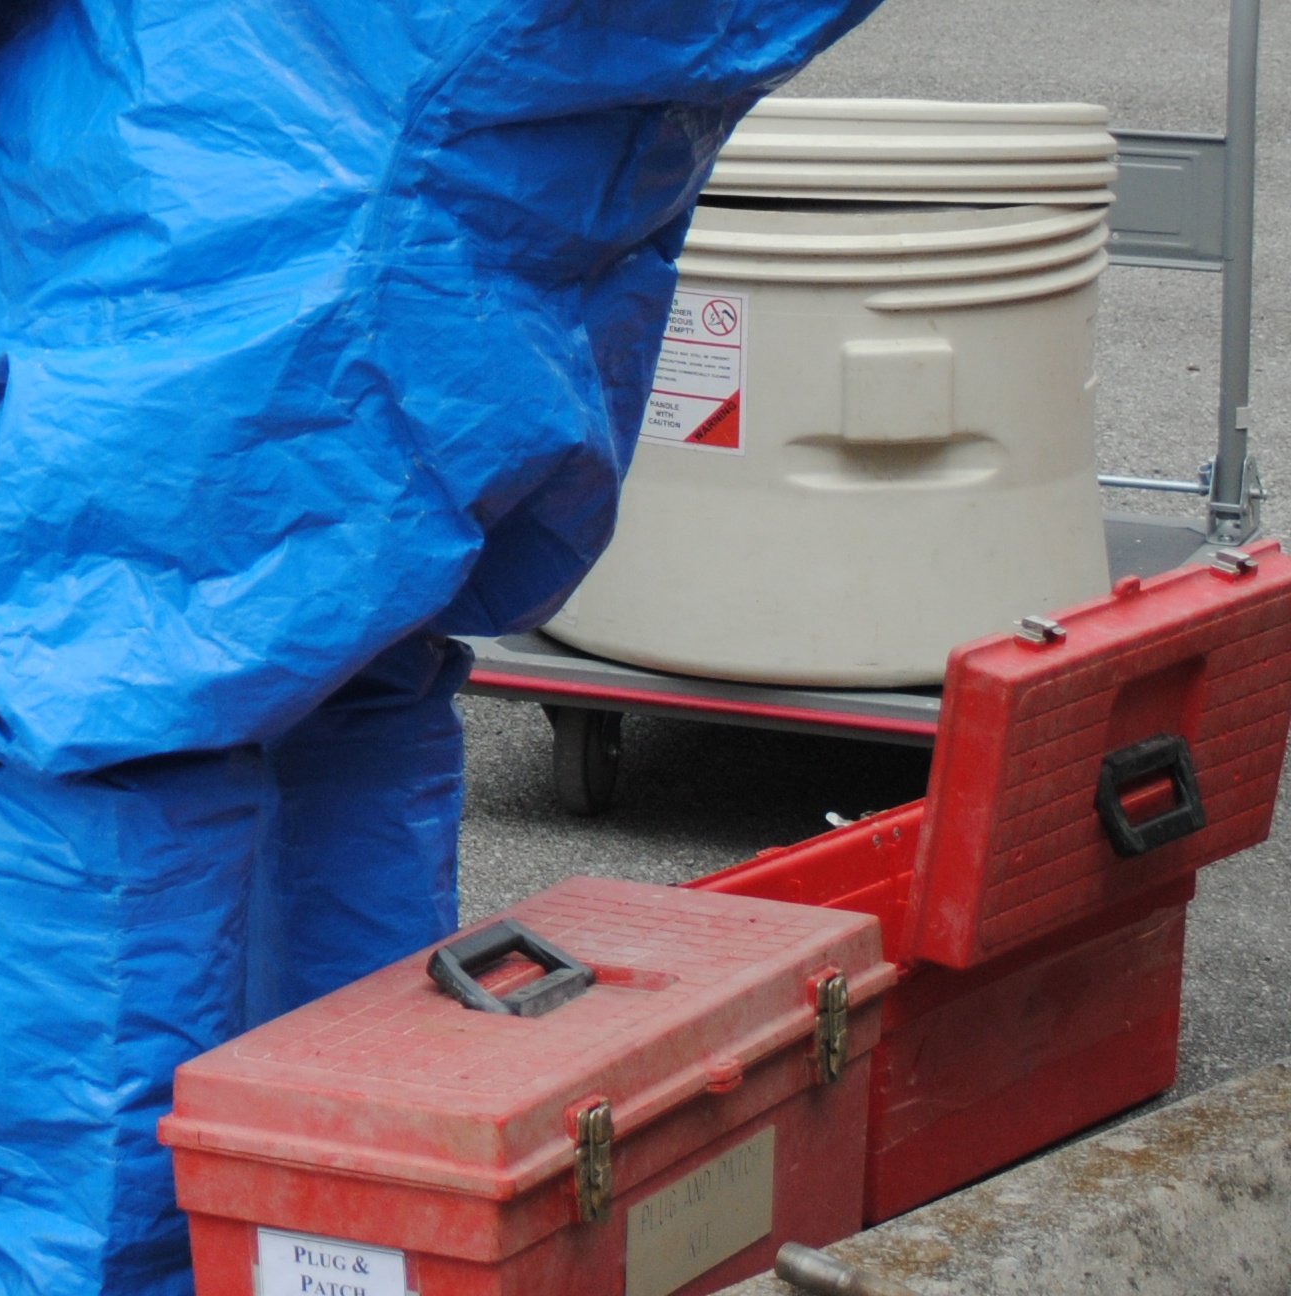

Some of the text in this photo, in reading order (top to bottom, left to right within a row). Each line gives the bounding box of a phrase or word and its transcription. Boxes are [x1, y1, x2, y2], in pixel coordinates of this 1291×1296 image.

[649, 399, 680, 411] HANDLE
[655, 409, 674, 419] WITH
[647, 417, 681, 429] CAUTION
[695, 400, 738, 441] WARNING
[293, 1245, 370, 1275] PLUG &
